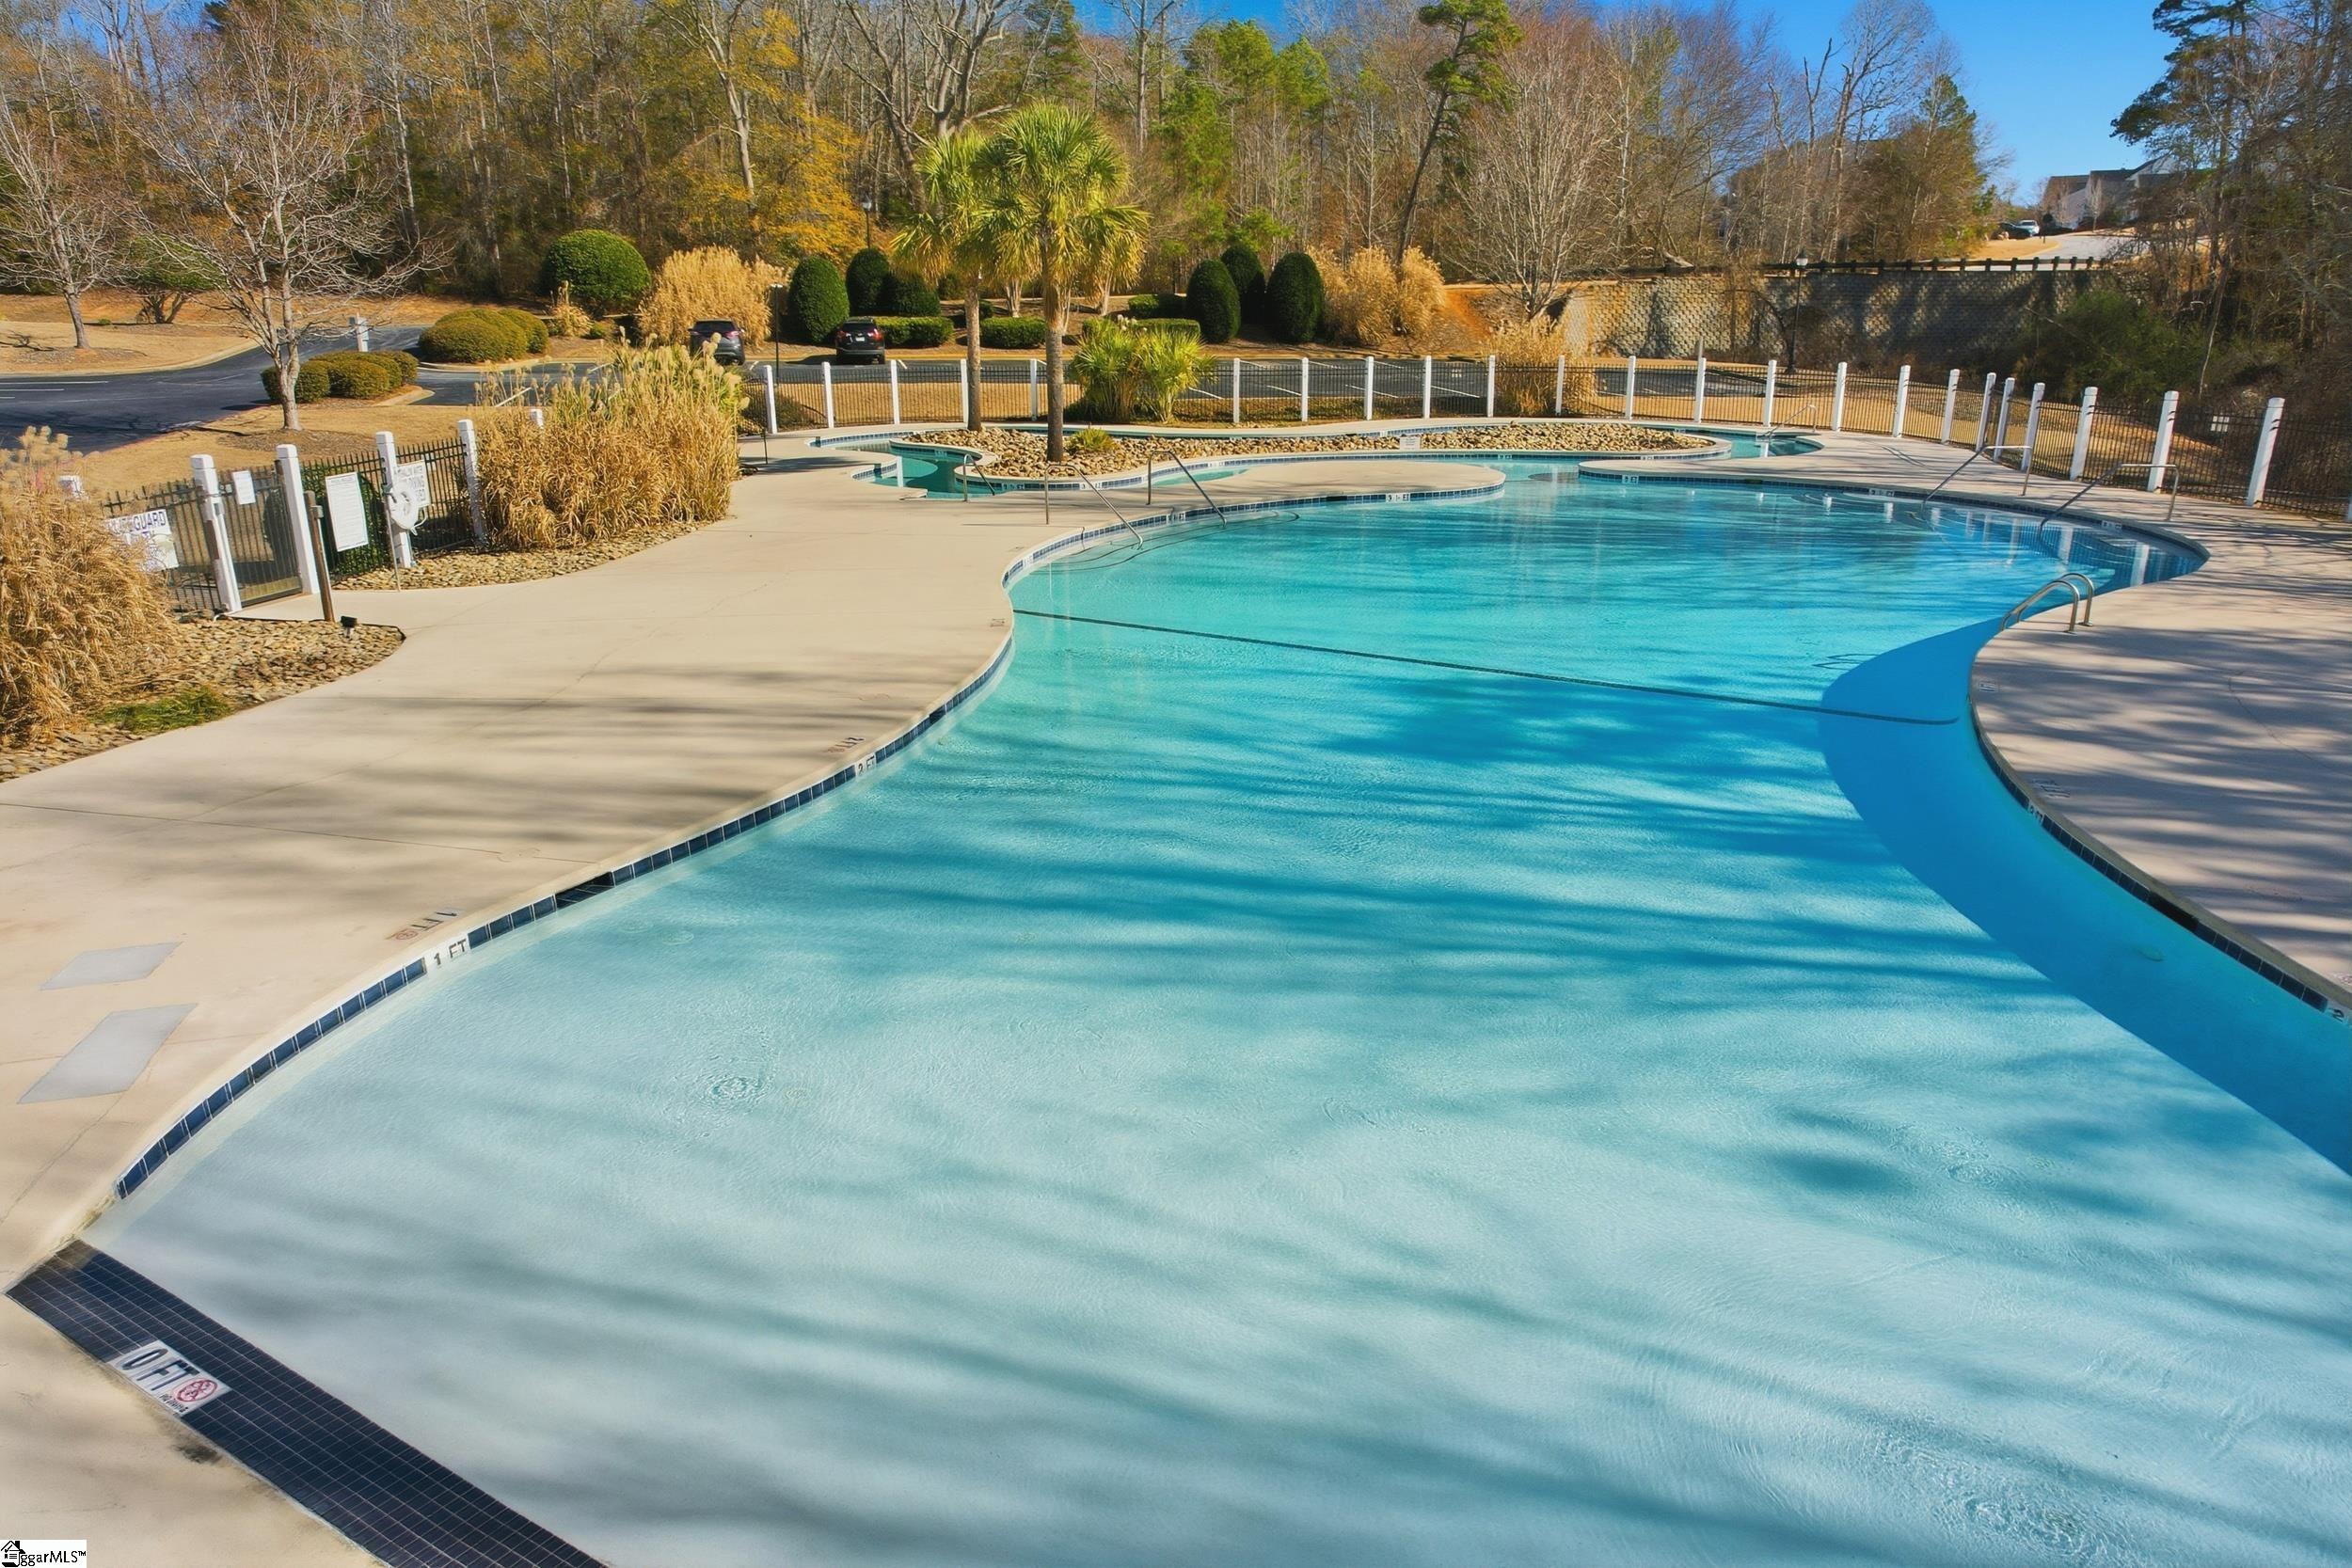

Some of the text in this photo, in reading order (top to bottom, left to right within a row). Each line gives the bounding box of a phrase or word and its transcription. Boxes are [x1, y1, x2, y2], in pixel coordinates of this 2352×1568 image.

[433, 939, 468, 967] 1 FT
[135, 1357, 200, 1392] FT
